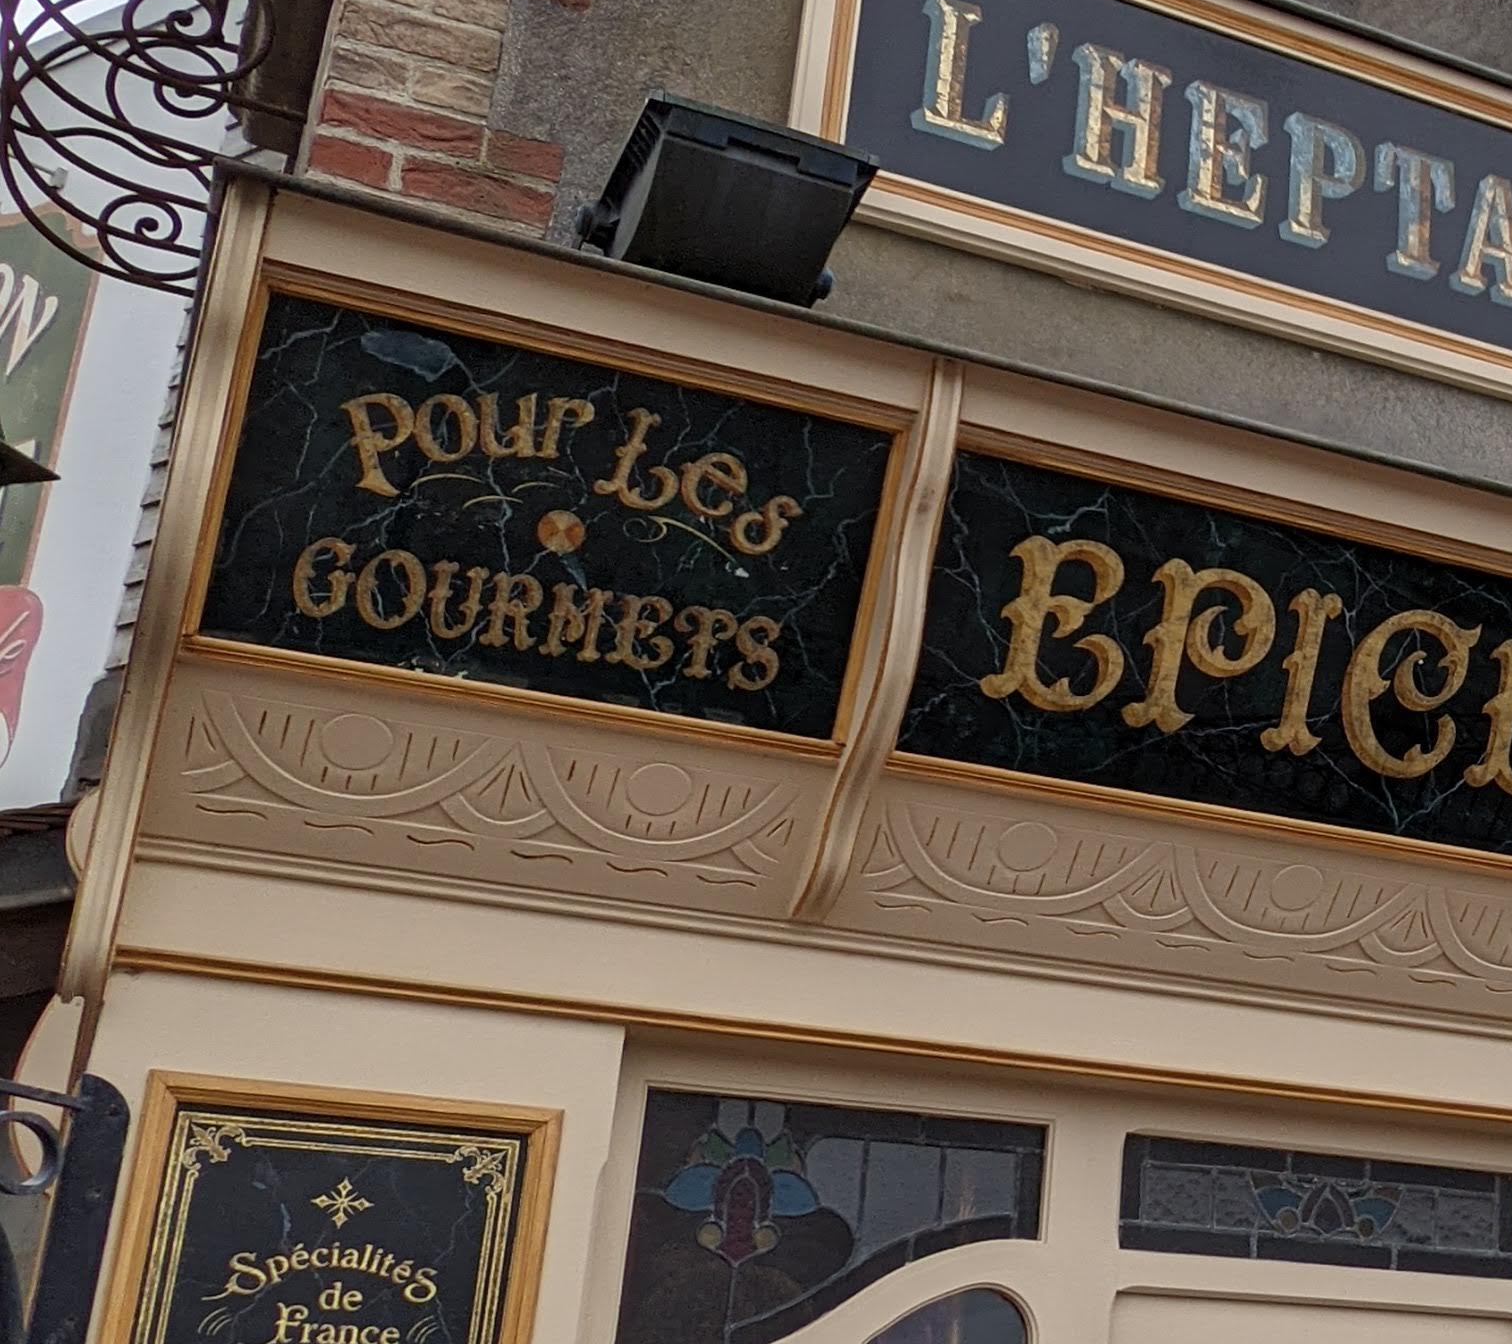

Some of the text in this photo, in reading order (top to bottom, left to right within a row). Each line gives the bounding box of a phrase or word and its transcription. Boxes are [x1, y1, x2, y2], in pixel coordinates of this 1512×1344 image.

[292, 537, 782, 691] GOURMETS
[202, 1242, 438, 1303] Spécialités
[318, 1281, 363, 1311] de
